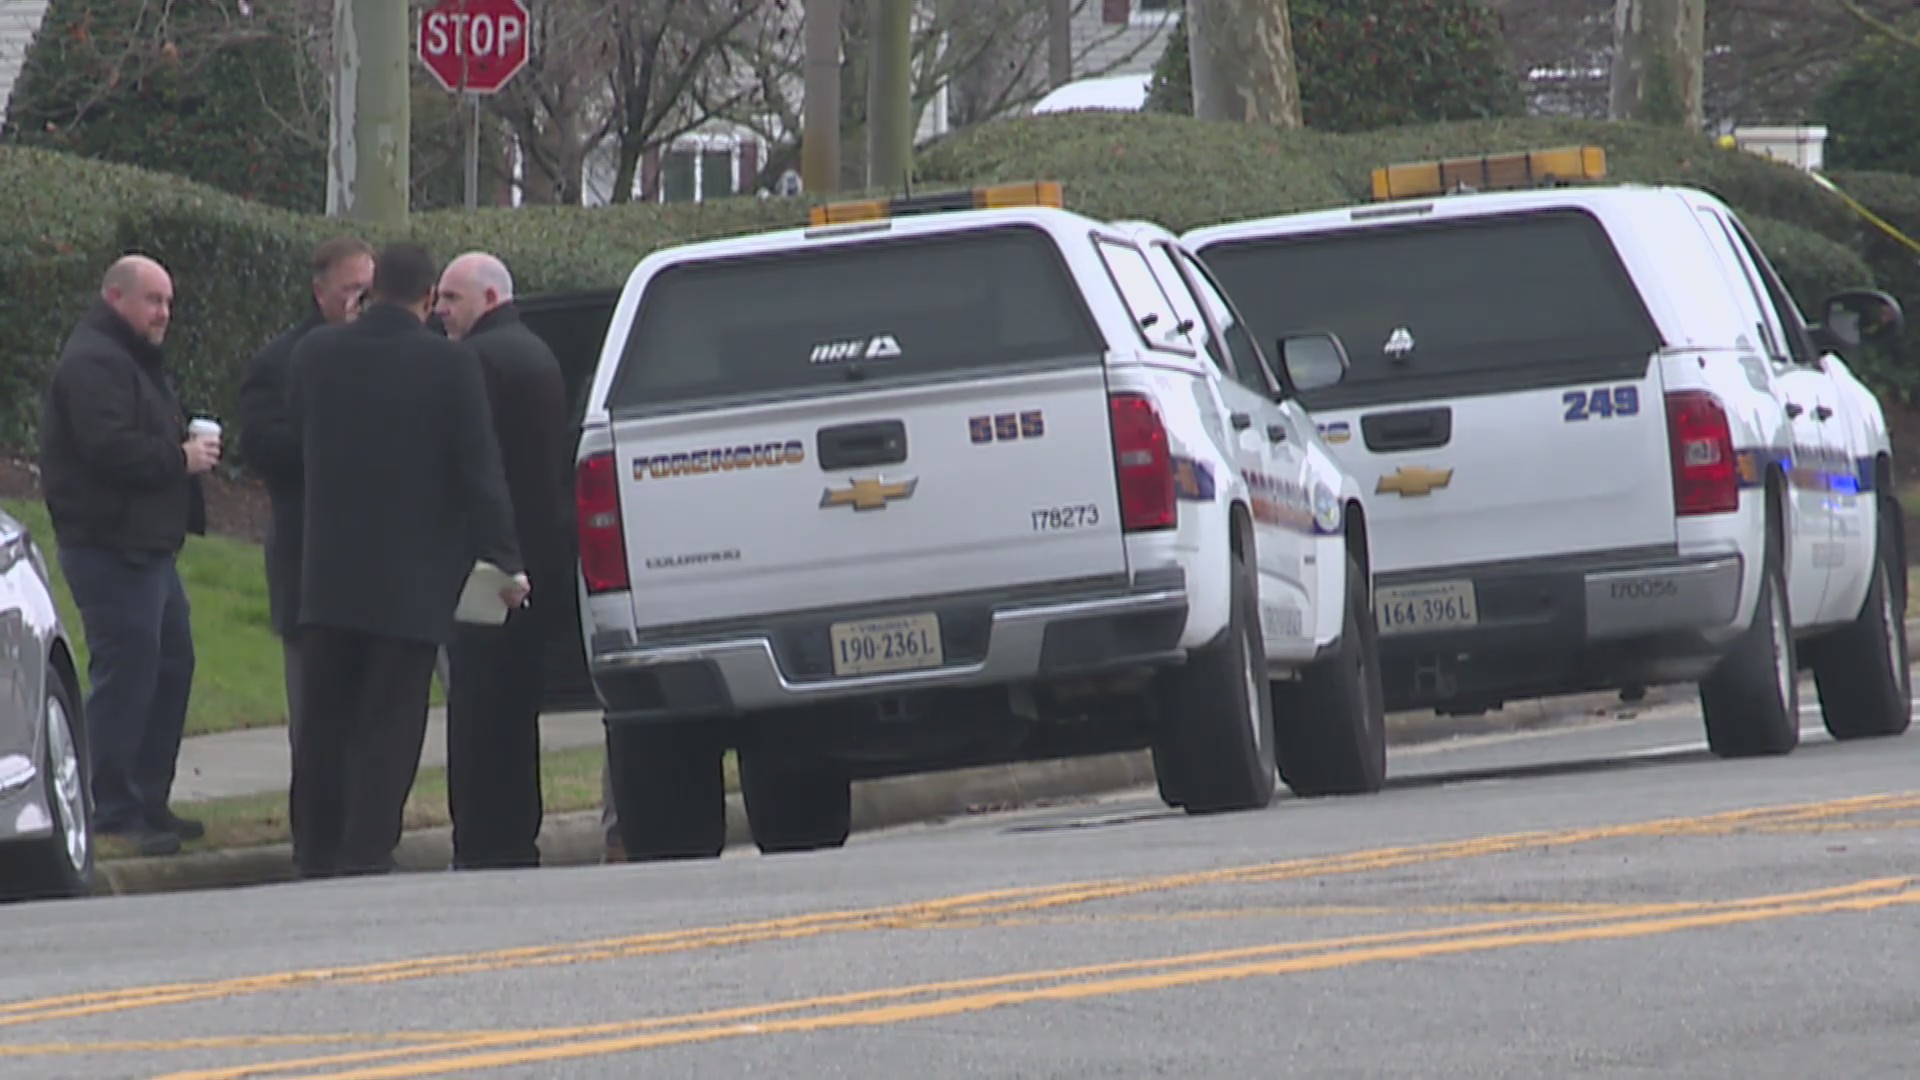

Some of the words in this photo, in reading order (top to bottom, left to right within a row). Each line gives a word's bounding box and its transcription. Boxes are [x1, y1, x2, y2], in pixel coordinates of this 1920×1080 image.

[428, 12, 519, 56] STOP
[1563, 386, 1639, 421] 249
[969, 411, 1043, 443] 555
[1032, 504, 1099, 530] 178273
